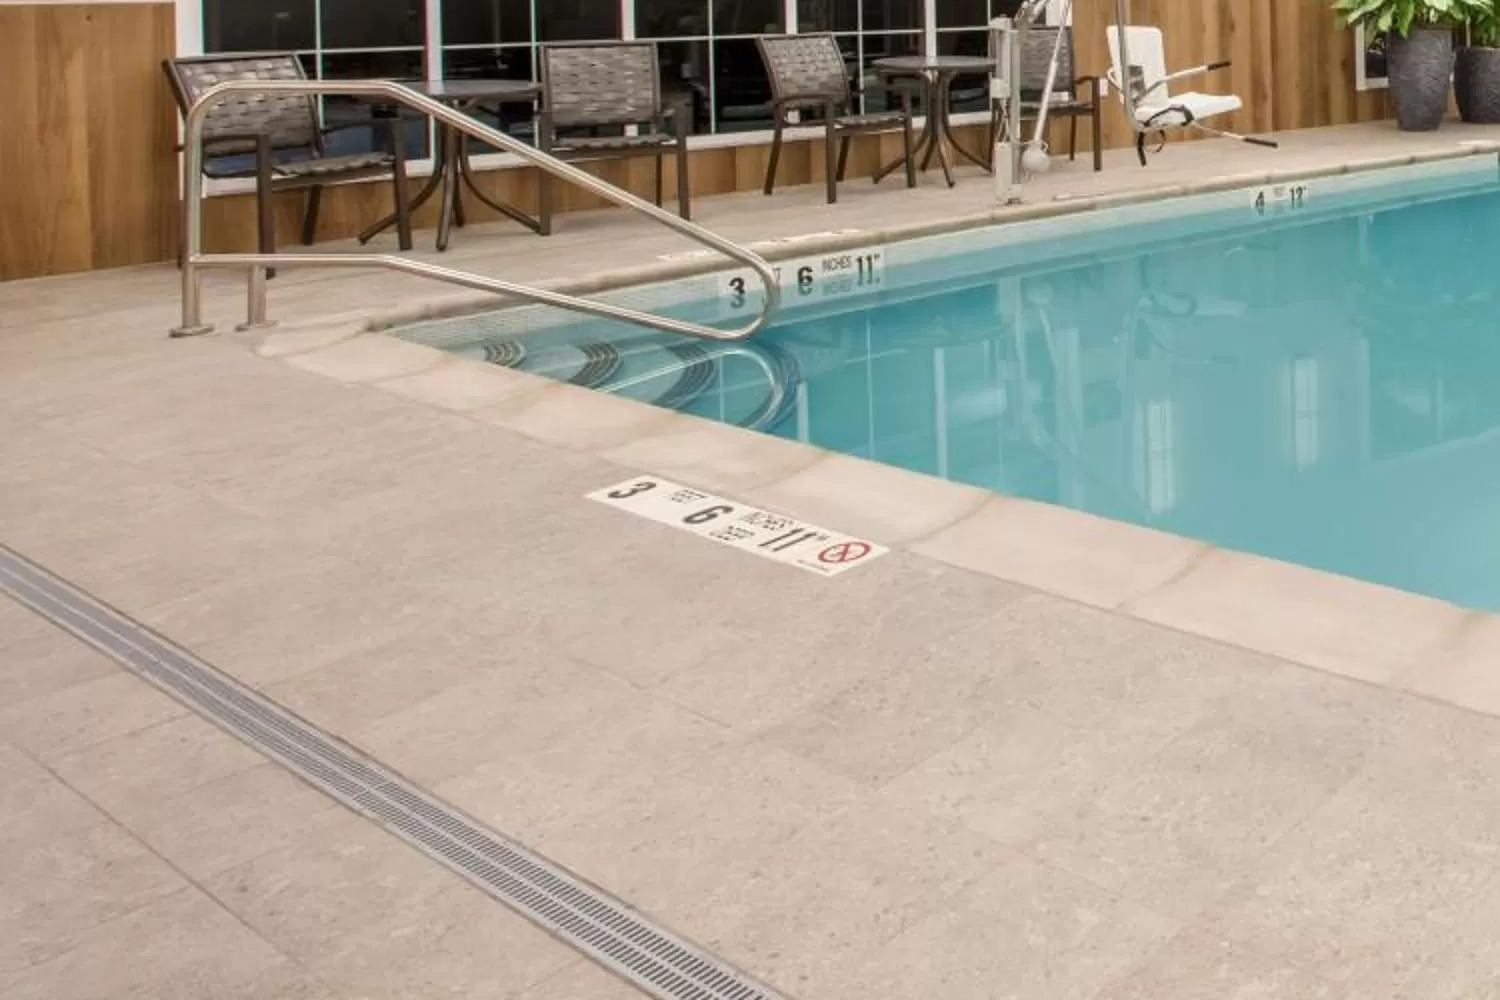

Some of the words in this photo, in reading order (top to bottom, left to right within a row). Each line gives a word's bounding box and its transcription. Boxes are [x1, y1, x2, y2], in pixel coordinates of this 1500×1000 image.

[729, 276, 745, 301] 3
[797, 266, 813, 289] 6
[607, 481, 657, 499] 3
[683, 505, 734, 524] 6
